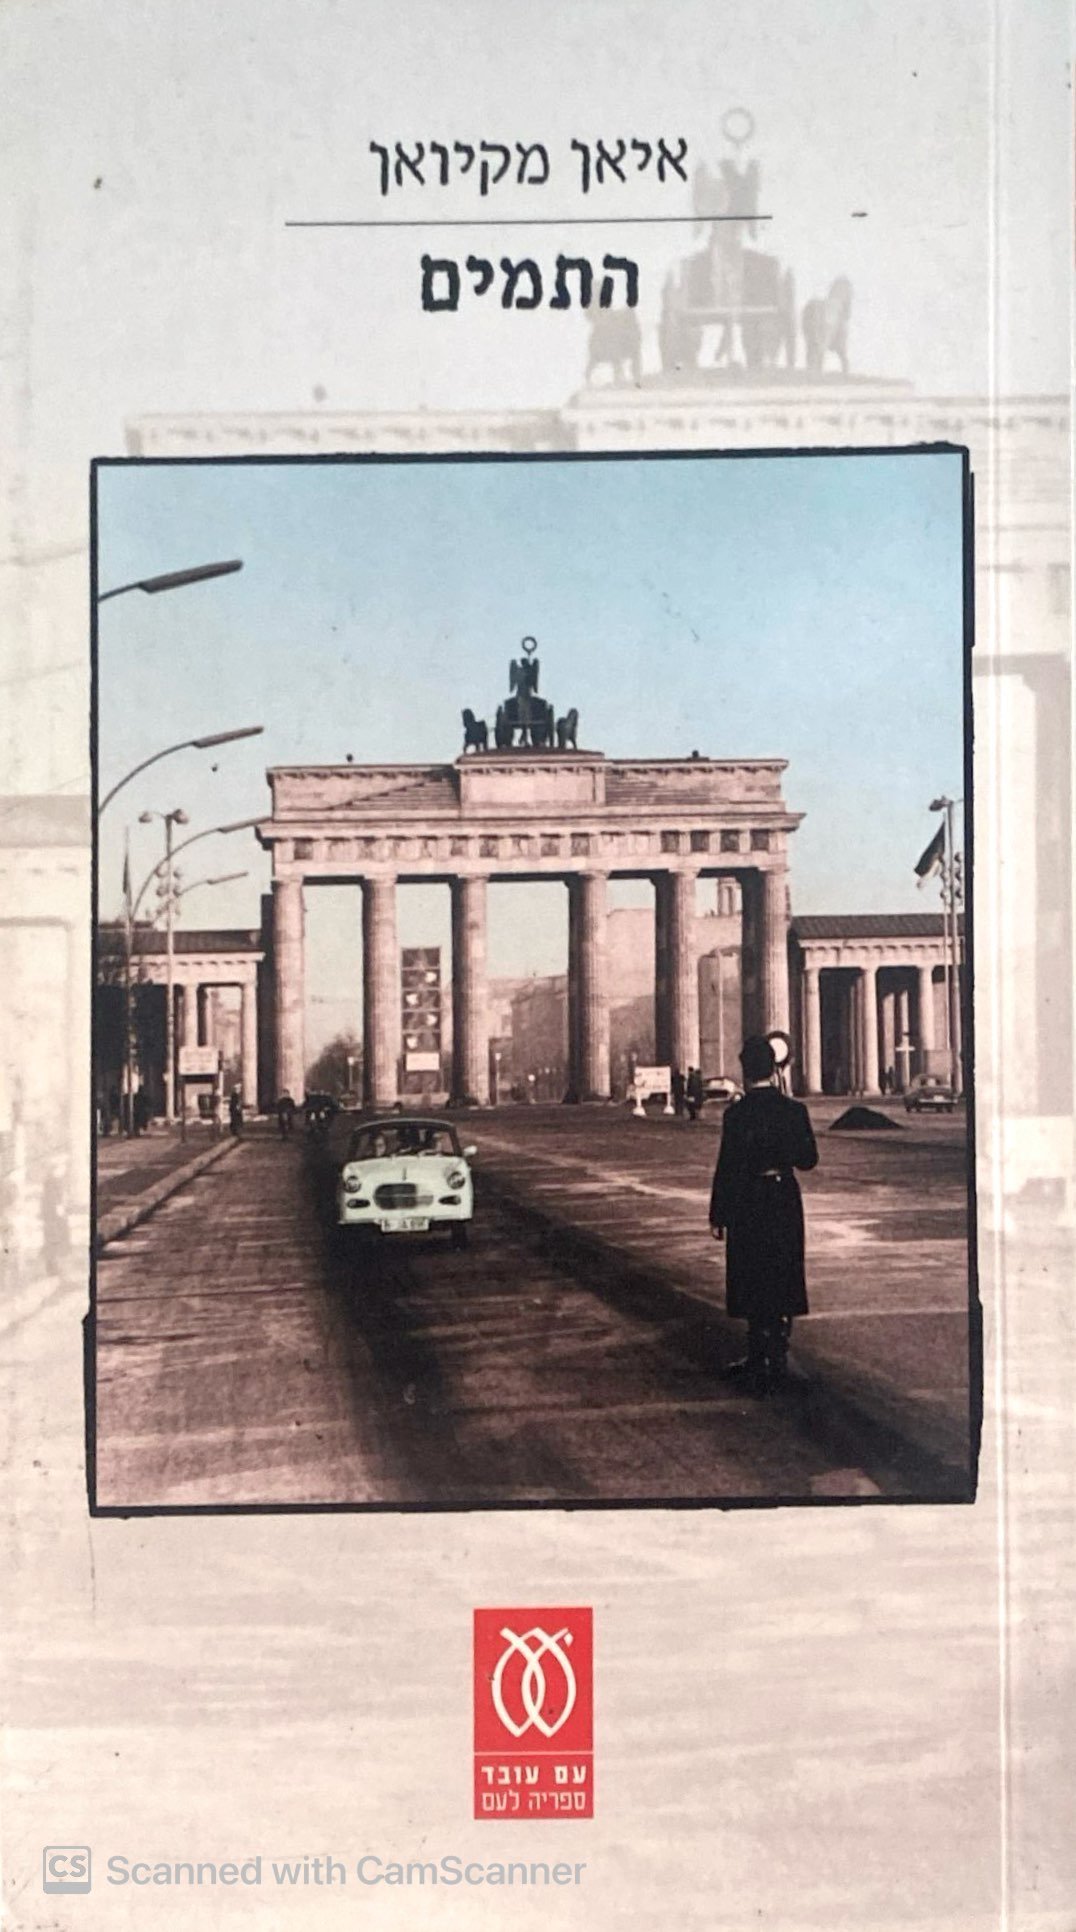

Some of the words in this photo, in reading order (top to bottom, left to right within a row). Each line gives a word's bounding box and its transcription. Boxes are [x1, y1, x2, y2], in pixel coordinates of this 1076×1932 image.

[369, 140, 549, 196] מקיואן
[571, 138, 688, 193] איאן
[421, 254, 639, 312] התמים
[481, 1766, 539, 1784] עובד
[554, 1766, 586, 1784] עם
[482, 1790, 520, 1811] לעם
[528, 1791, 586, 1810] ספריה
